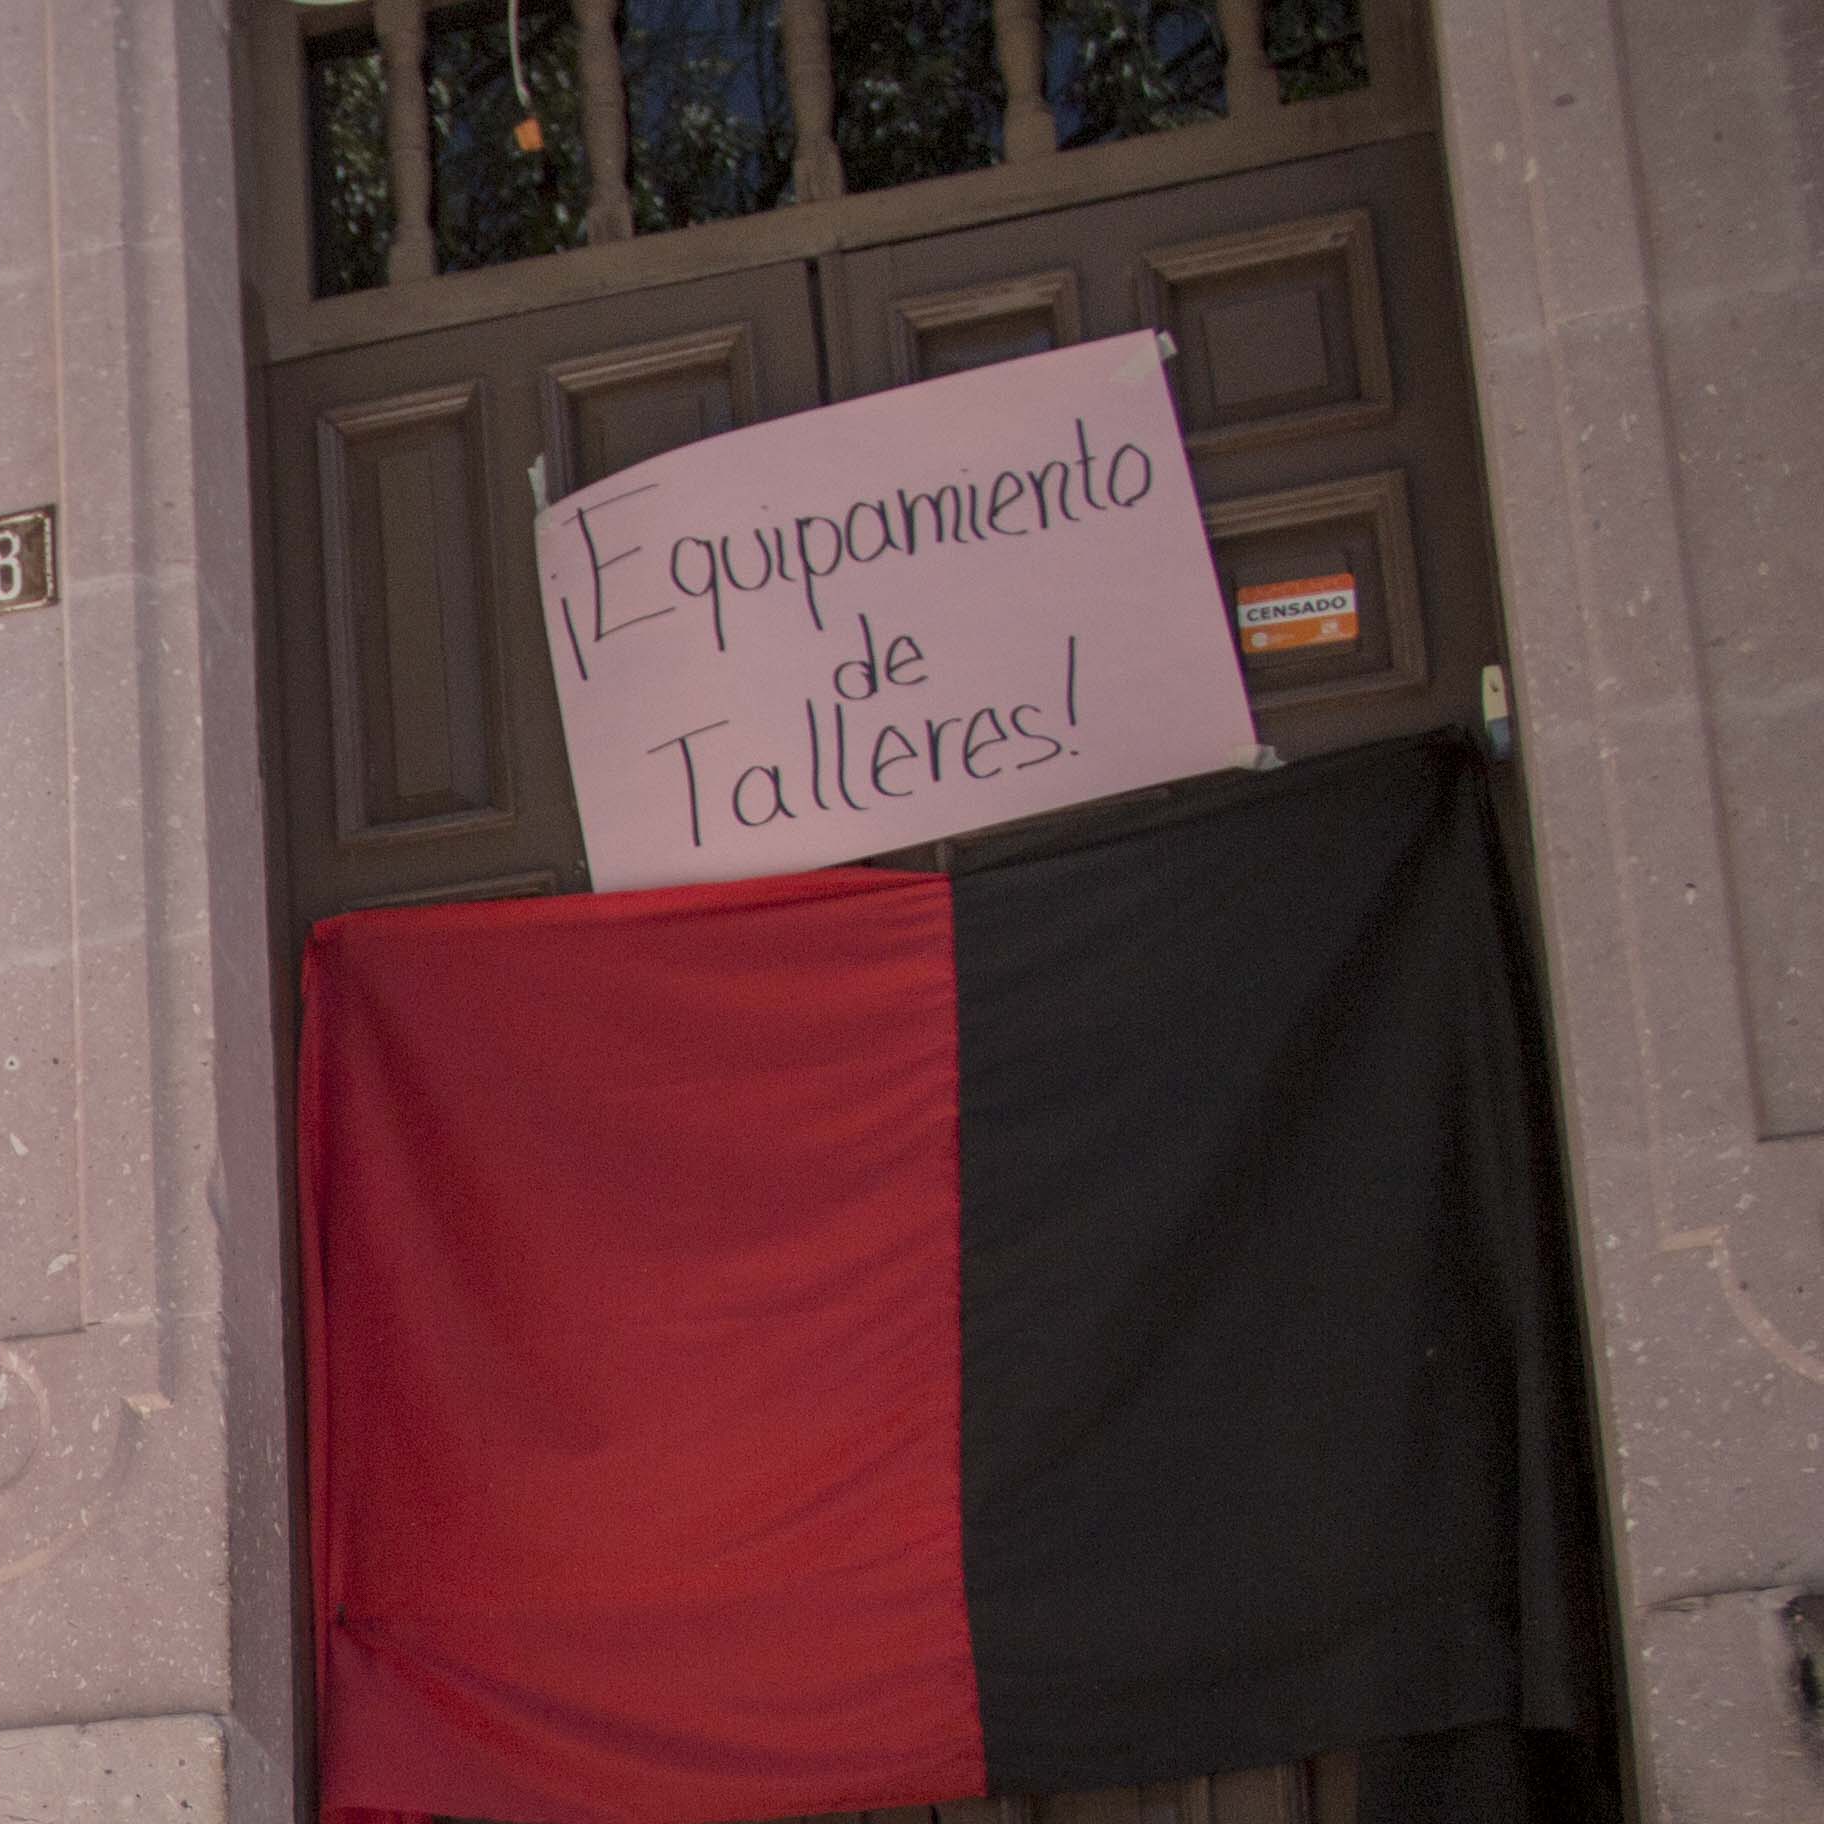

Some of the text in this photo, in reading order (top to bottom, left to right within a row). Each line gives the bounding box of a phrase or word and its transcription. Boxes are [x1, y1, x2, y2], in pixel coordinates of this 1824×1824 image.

[550, 418, 1153, 681] ¡Equipamiento
[1246, 595, 1347, 622] CENSADO
[833, 613, 928, 701] de
[647, 635, 1080, 848] Talleres!
